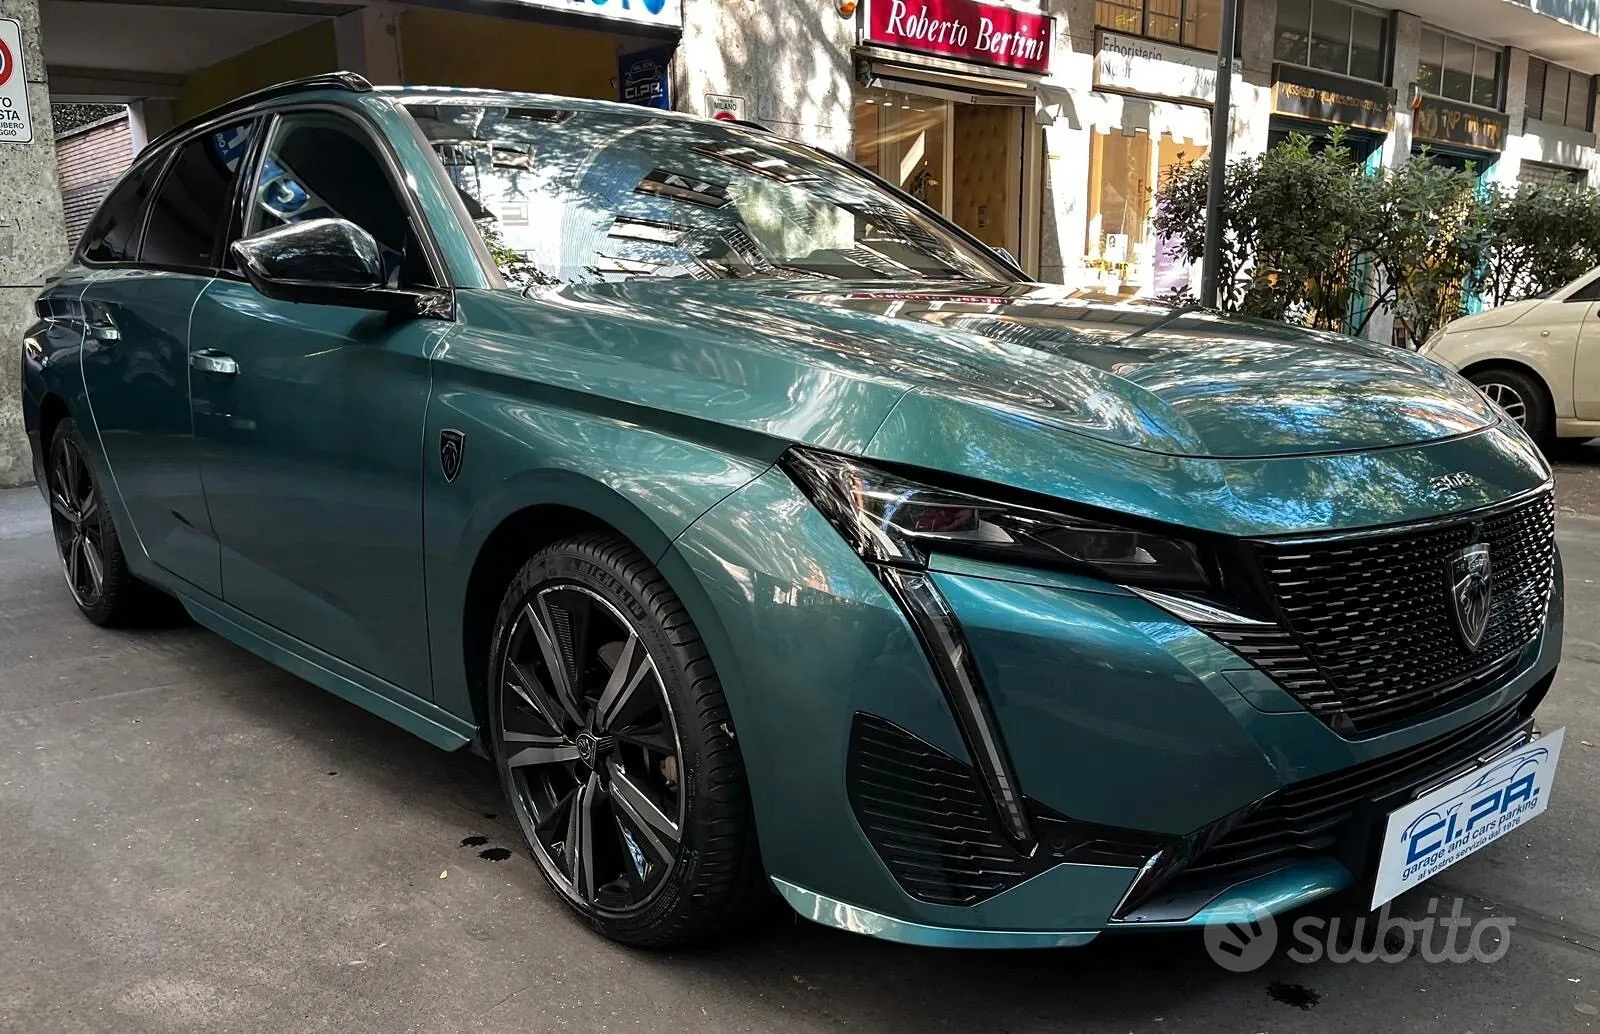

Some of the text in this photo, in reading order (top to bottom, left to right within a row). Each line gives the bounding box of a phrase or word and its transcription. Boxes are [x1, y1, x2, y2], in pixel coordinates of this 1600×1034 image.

[886, 0, 1046, 61] Roberto Bertini
[0, 97, 12, 107] O
[714, 102, 737, 111] MILANO
[1402, 797, 1538, 881] garage and cars parking
[1406, 772, 1540, 865] CI.PA.
[1417, 816, 1521, 881] al vostro servizio dal 1976
